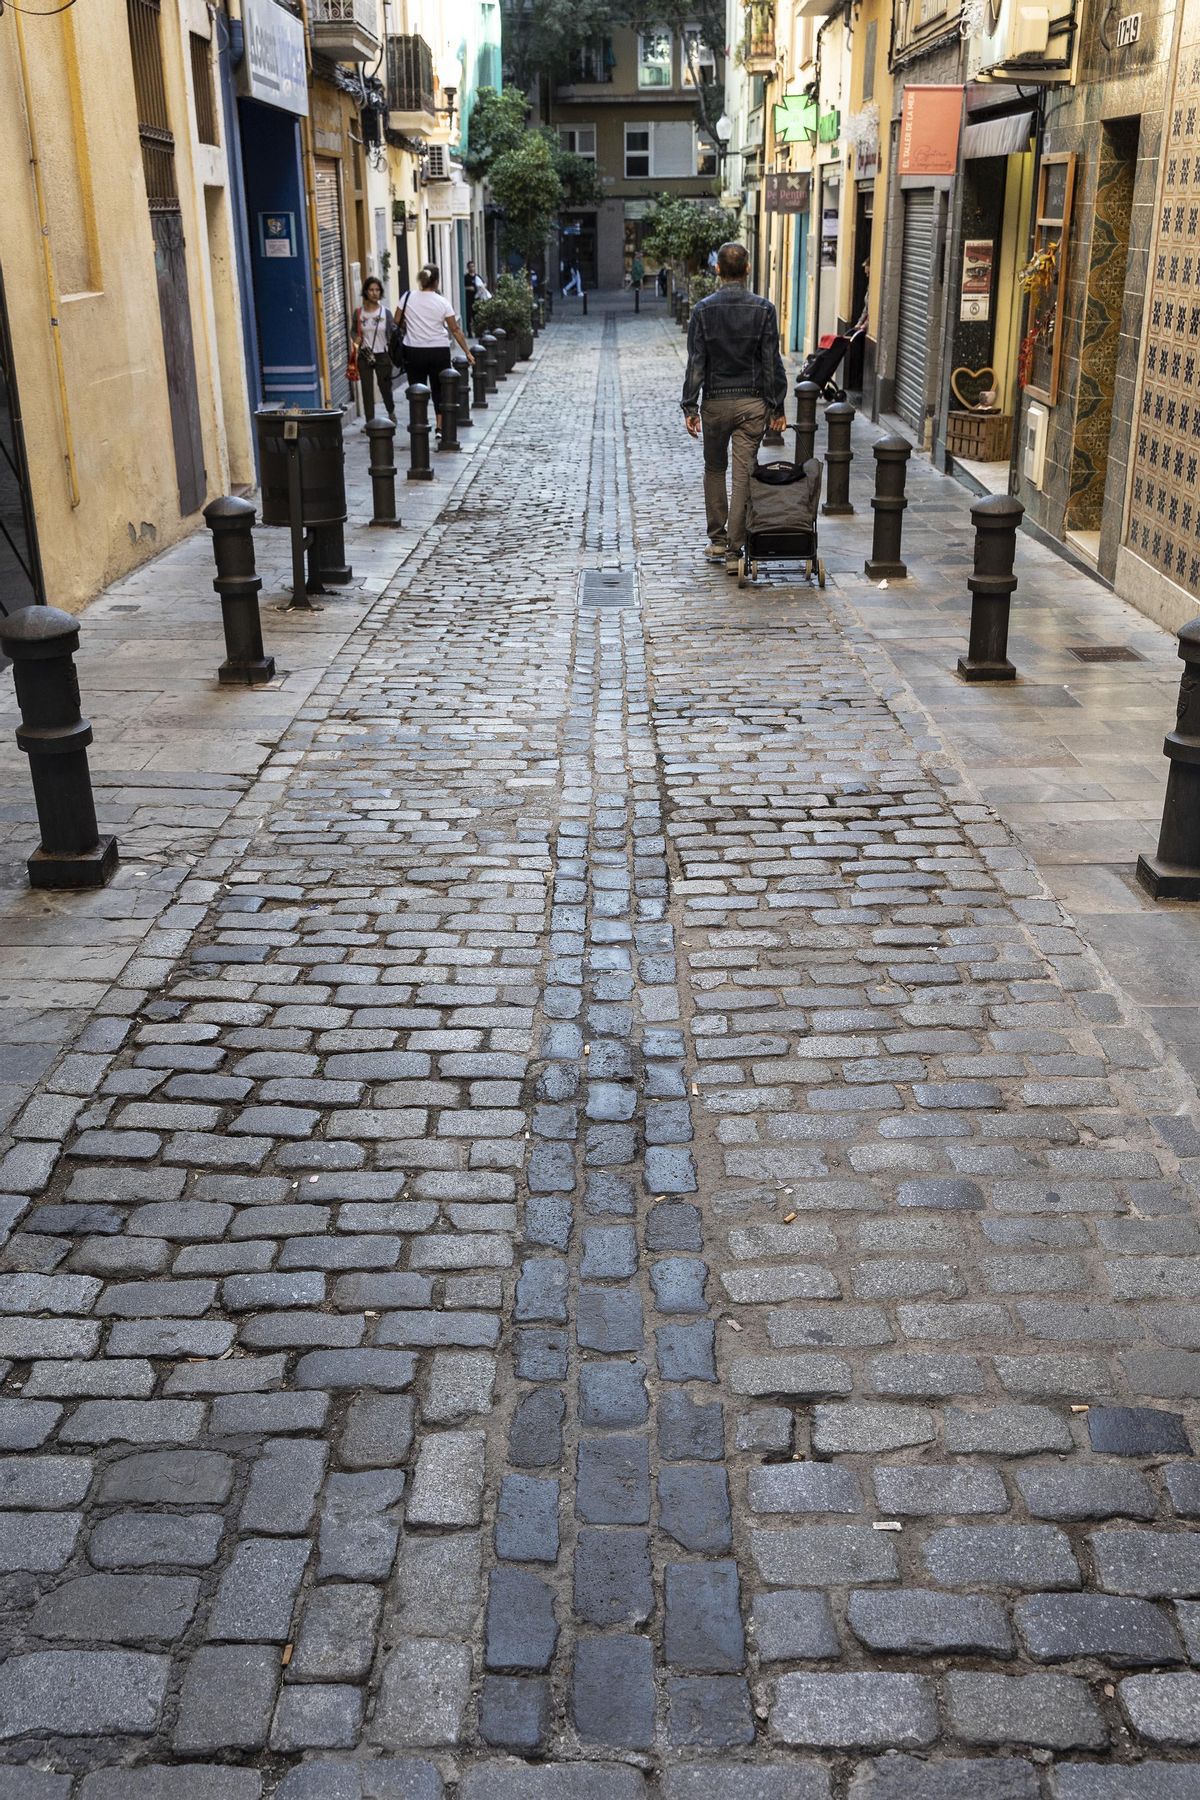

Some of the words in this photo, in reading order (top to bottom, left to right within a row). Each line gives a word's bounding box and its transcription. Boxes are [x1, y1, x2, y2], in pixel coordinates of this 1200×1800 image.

[1118, 16, 1138, 45] 17-19
[906, 110, 913, 119] LA
[905, 119, 912, 131] DE
[903, 131, 911, 158] TALLER
[902, 160, 909, 168] EL
